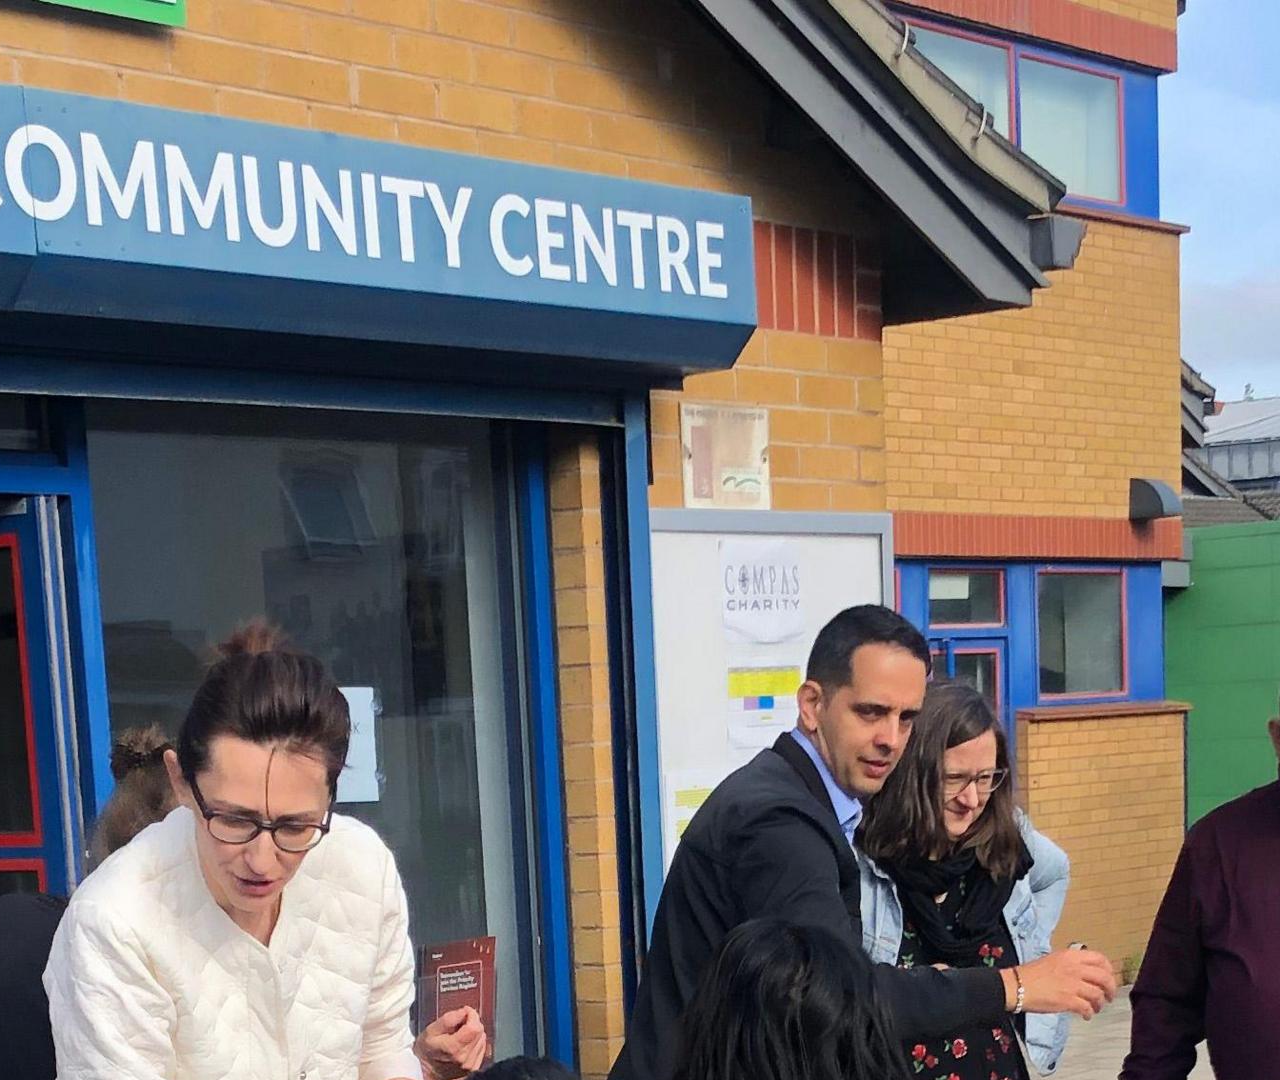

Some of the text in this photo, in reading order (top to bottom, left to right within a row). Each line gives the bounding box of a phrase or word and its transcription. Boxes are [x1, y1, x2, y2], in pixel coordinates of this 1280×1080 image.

[489, 194, 729, 299] CENTRE
[724, 564, 800, 595] COMPAS
[726, 599, 800, 611] CHARITY
